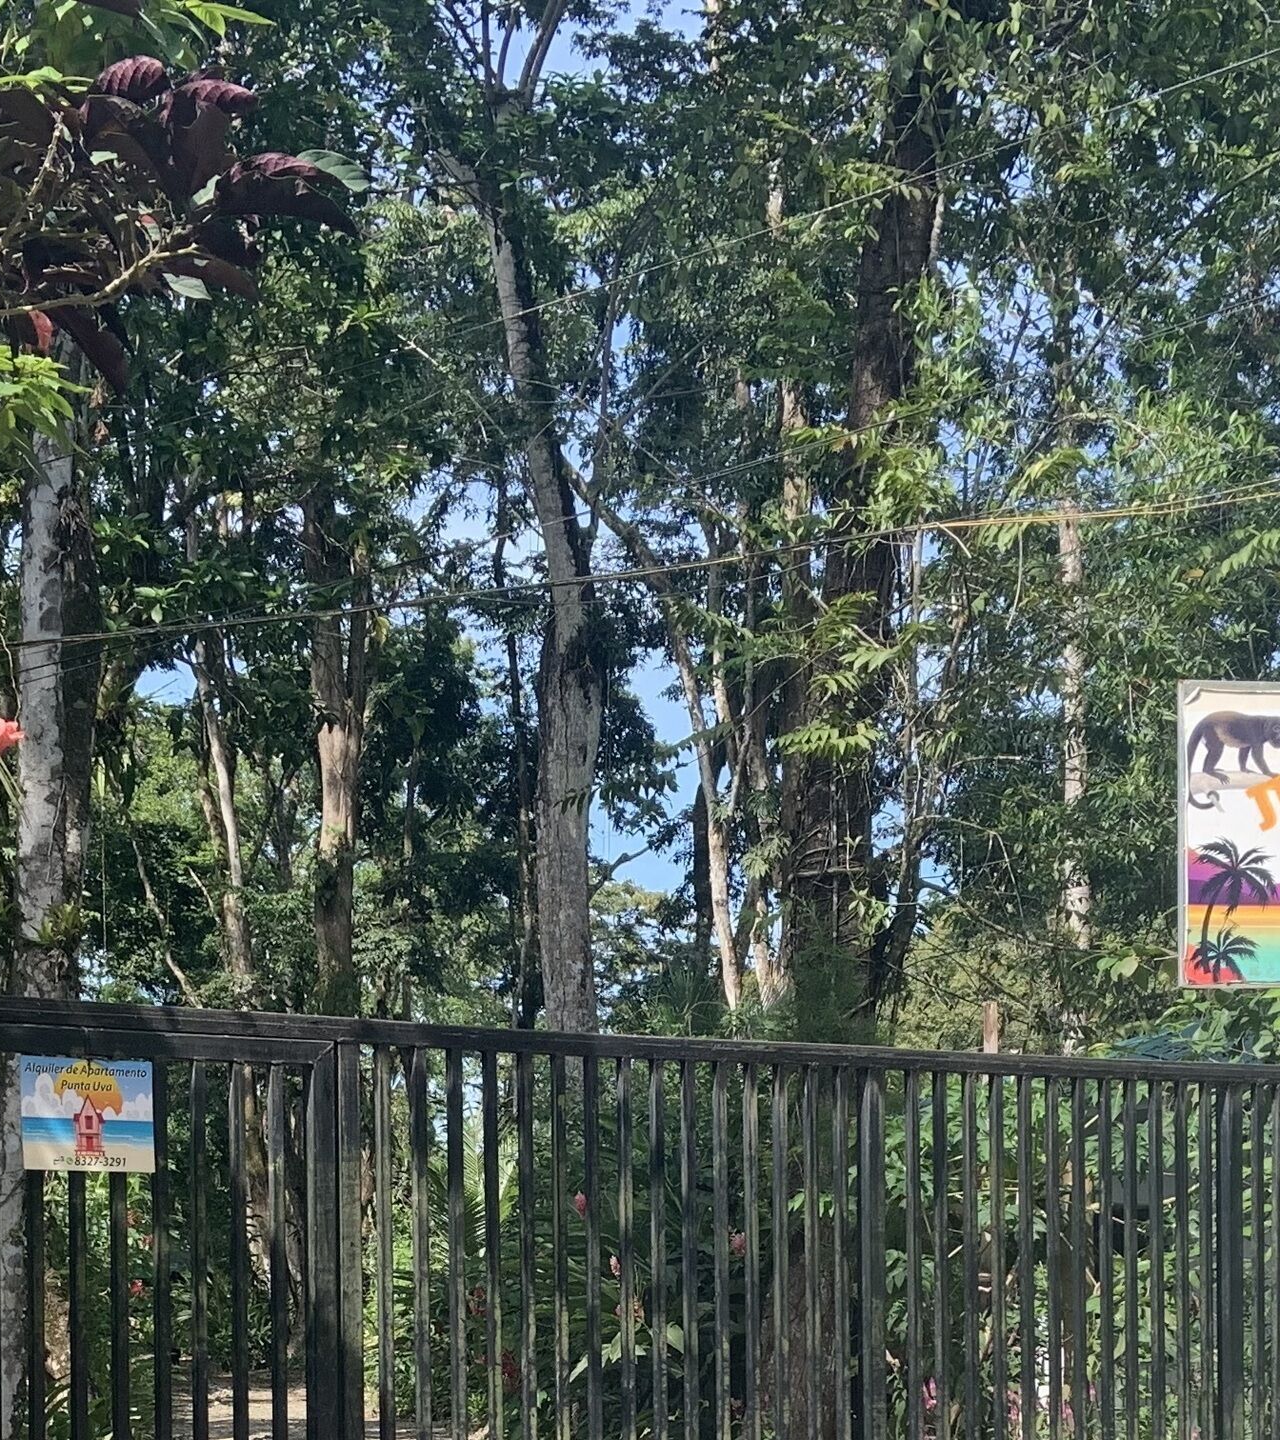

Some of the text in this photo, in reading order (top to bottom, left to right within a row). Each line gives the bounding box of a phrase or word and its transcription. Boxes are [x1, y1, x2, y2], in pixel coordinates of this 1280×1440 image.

[24, 1062, 147, 1078] Alquiler de Apartamento
[60, 1079, 112, 1092] Punta Uva
[74, 1156, 126, 1168] 8327-3291
